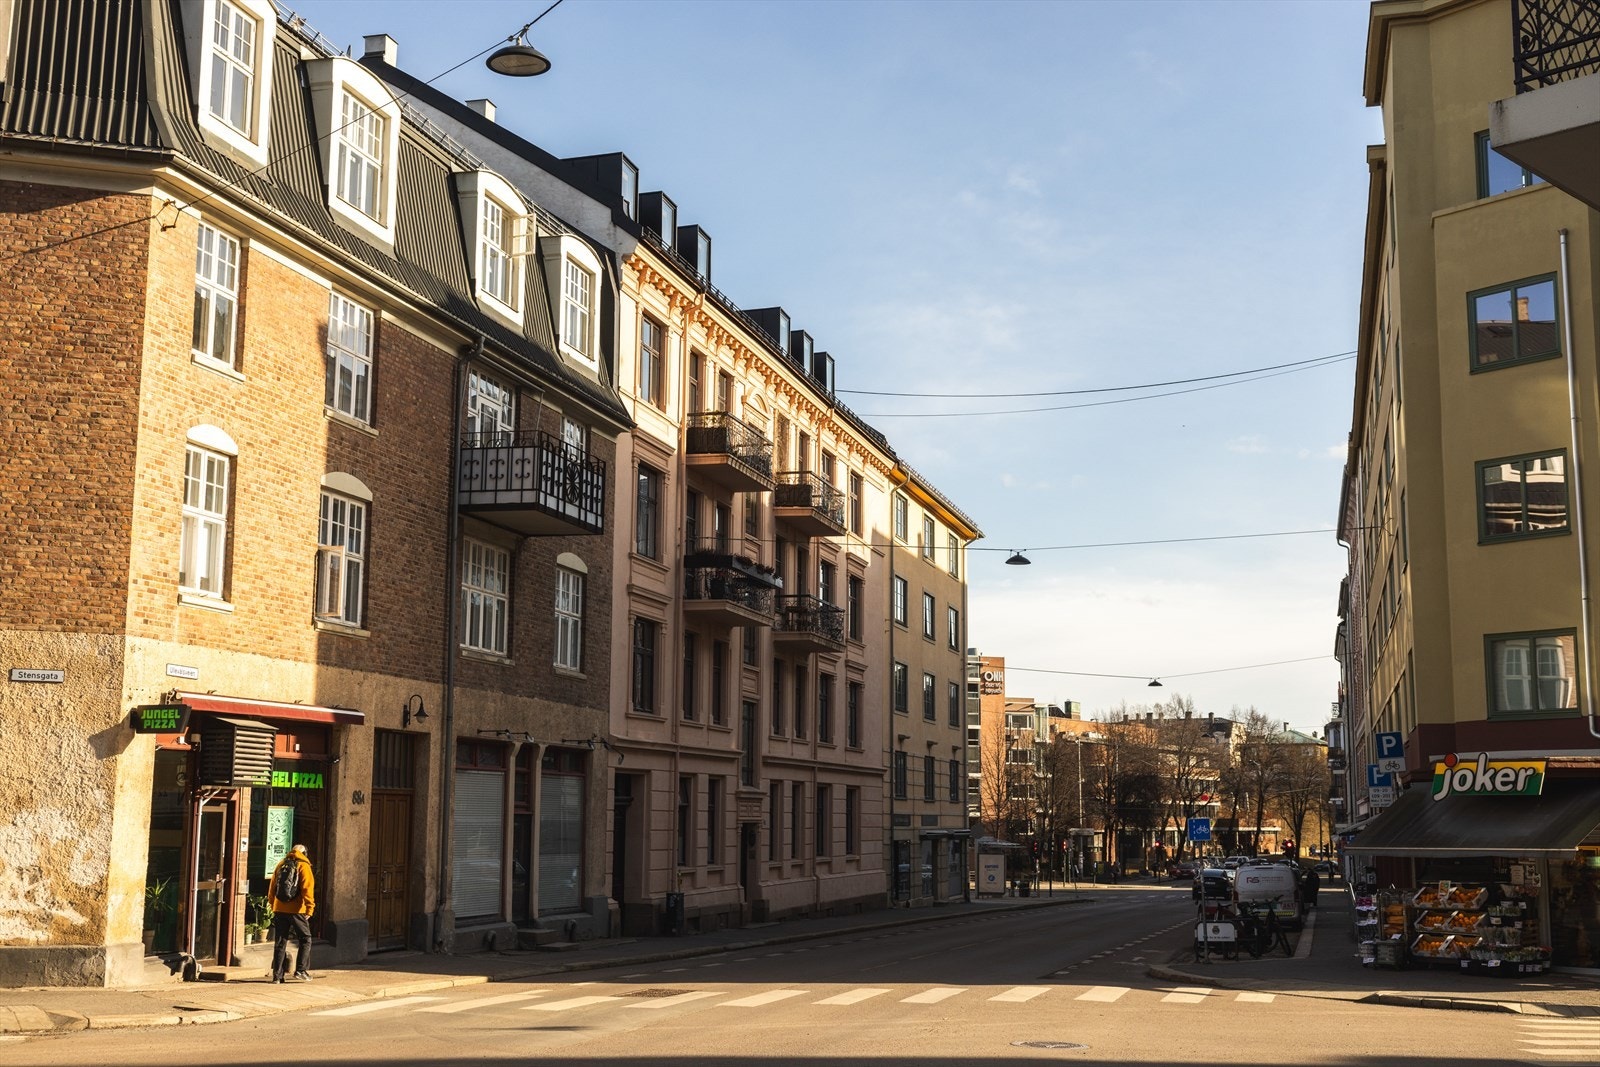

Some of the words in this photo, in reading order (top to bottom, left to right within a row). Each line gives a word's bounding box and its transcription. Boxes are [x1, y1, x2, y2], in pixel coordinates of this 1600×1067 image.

[17, 671, 59, 681] Stensgata
[984, 671, 1004, 682] ONH
[141, 709, 181, 719] JUNGEL
[143, 719, 177, 729] PIZZA
[1381, 735, 1397, 756] P
[291, 772, 324, 789] PIZZA
[1433, 752, 1536, 801] joker
